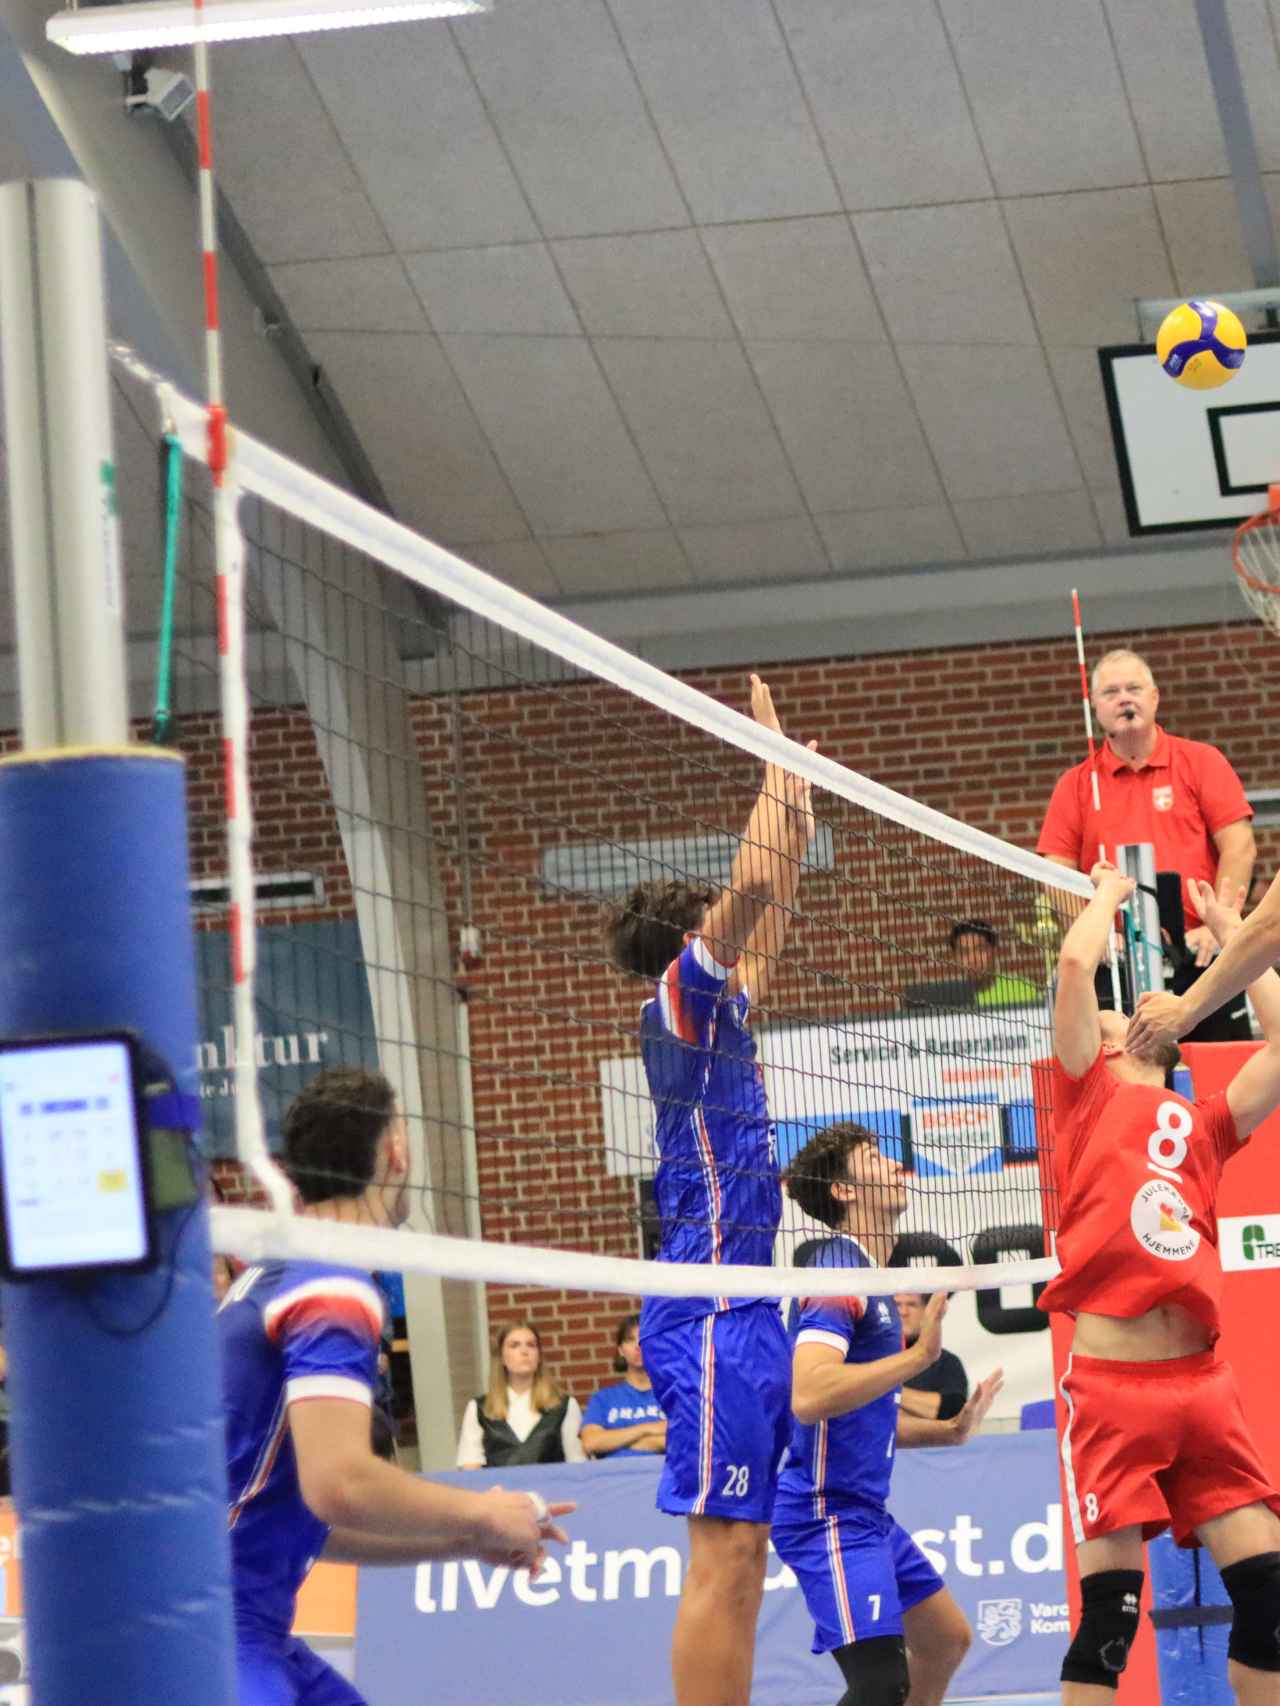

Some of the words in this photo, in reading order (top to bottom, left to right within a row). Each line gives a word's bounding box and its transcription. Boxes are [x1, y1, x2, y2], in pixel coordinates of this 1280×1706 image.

[831, 1045, 898, 1066] Service
[926, 1034, 1029, 1056] Reparation
[922, 1108, 991, 1129] BOSCH
[1147, 1101, 1193, 1170] 8
[722, 1465, 749, 1497] 28
[1084, 1493, 1099, 1522] 8
[868, 1594, 880, 1621] 7
